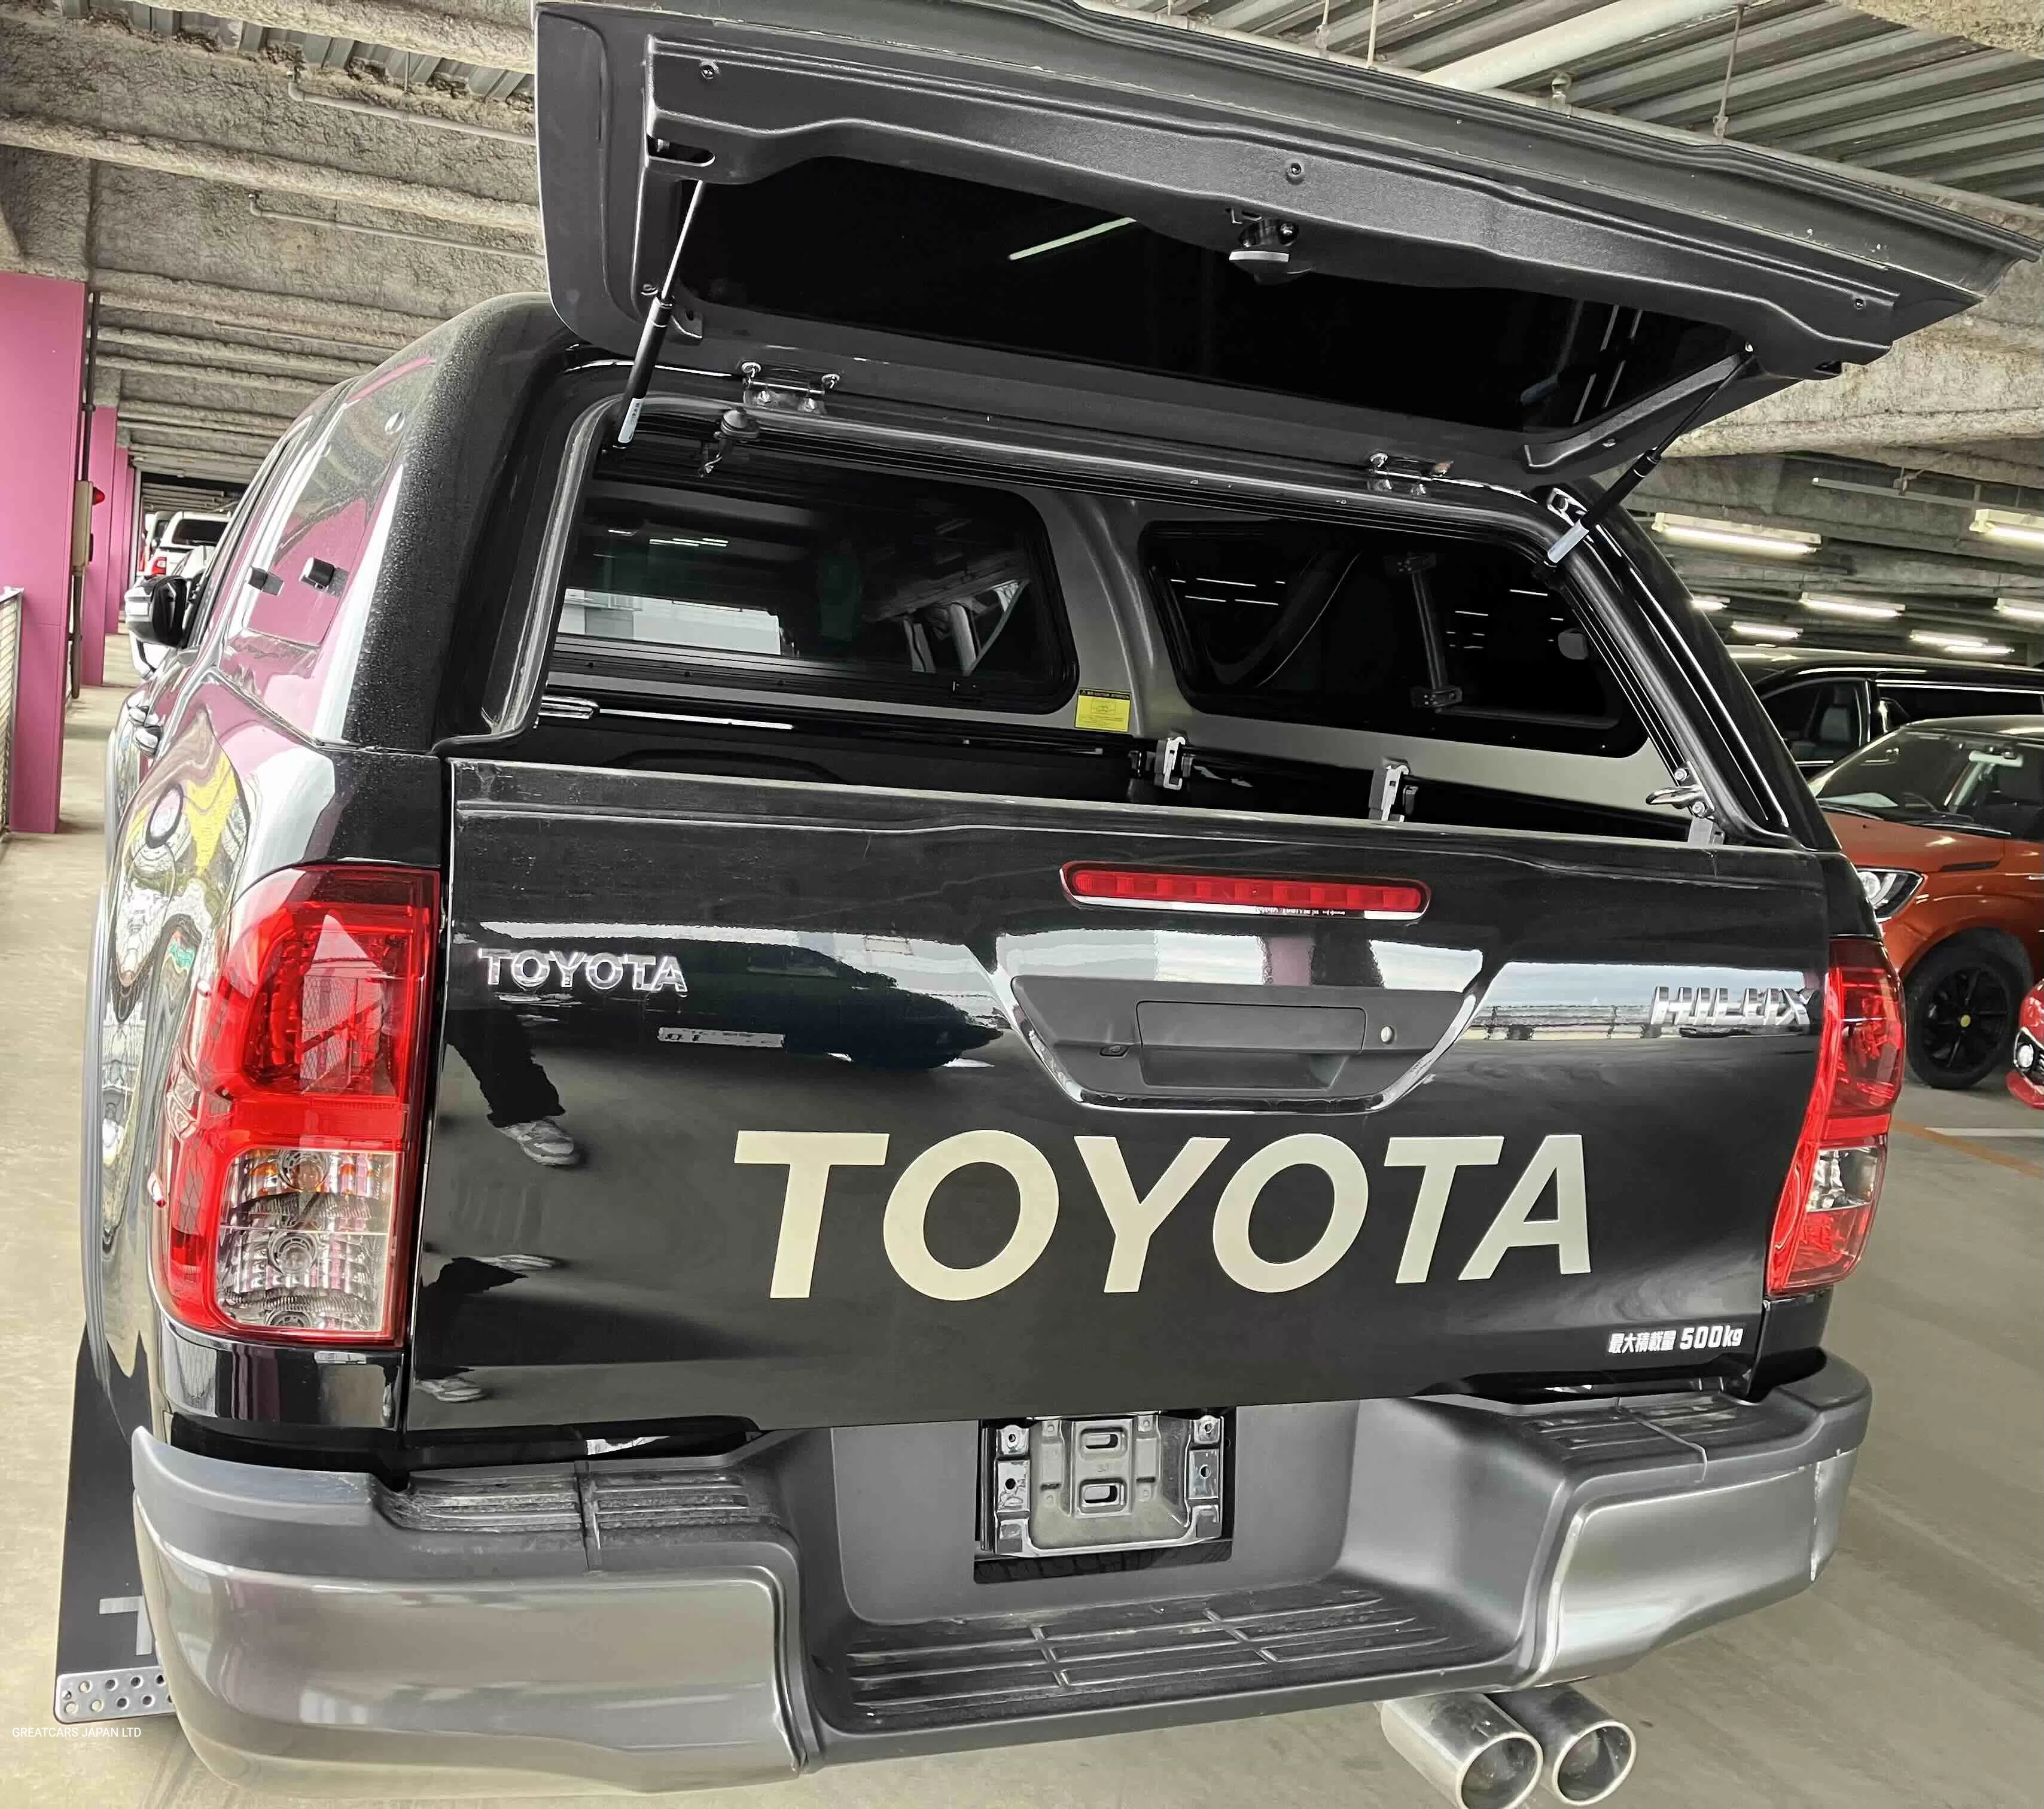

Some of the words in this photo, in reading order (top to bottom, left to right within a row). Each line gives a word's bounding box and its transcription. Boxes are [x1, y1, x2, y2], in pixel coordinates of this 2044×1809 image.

[477, 948, 688, 994] TOYOTA
[1649, 986, 1813, 1025] HILUX
[734, 1129, 1591, 1302] TOYOTA
[1608, 1330, 1677, 1354] 最大積載量
[1679, 1324, 1744, 1350] 500kg
